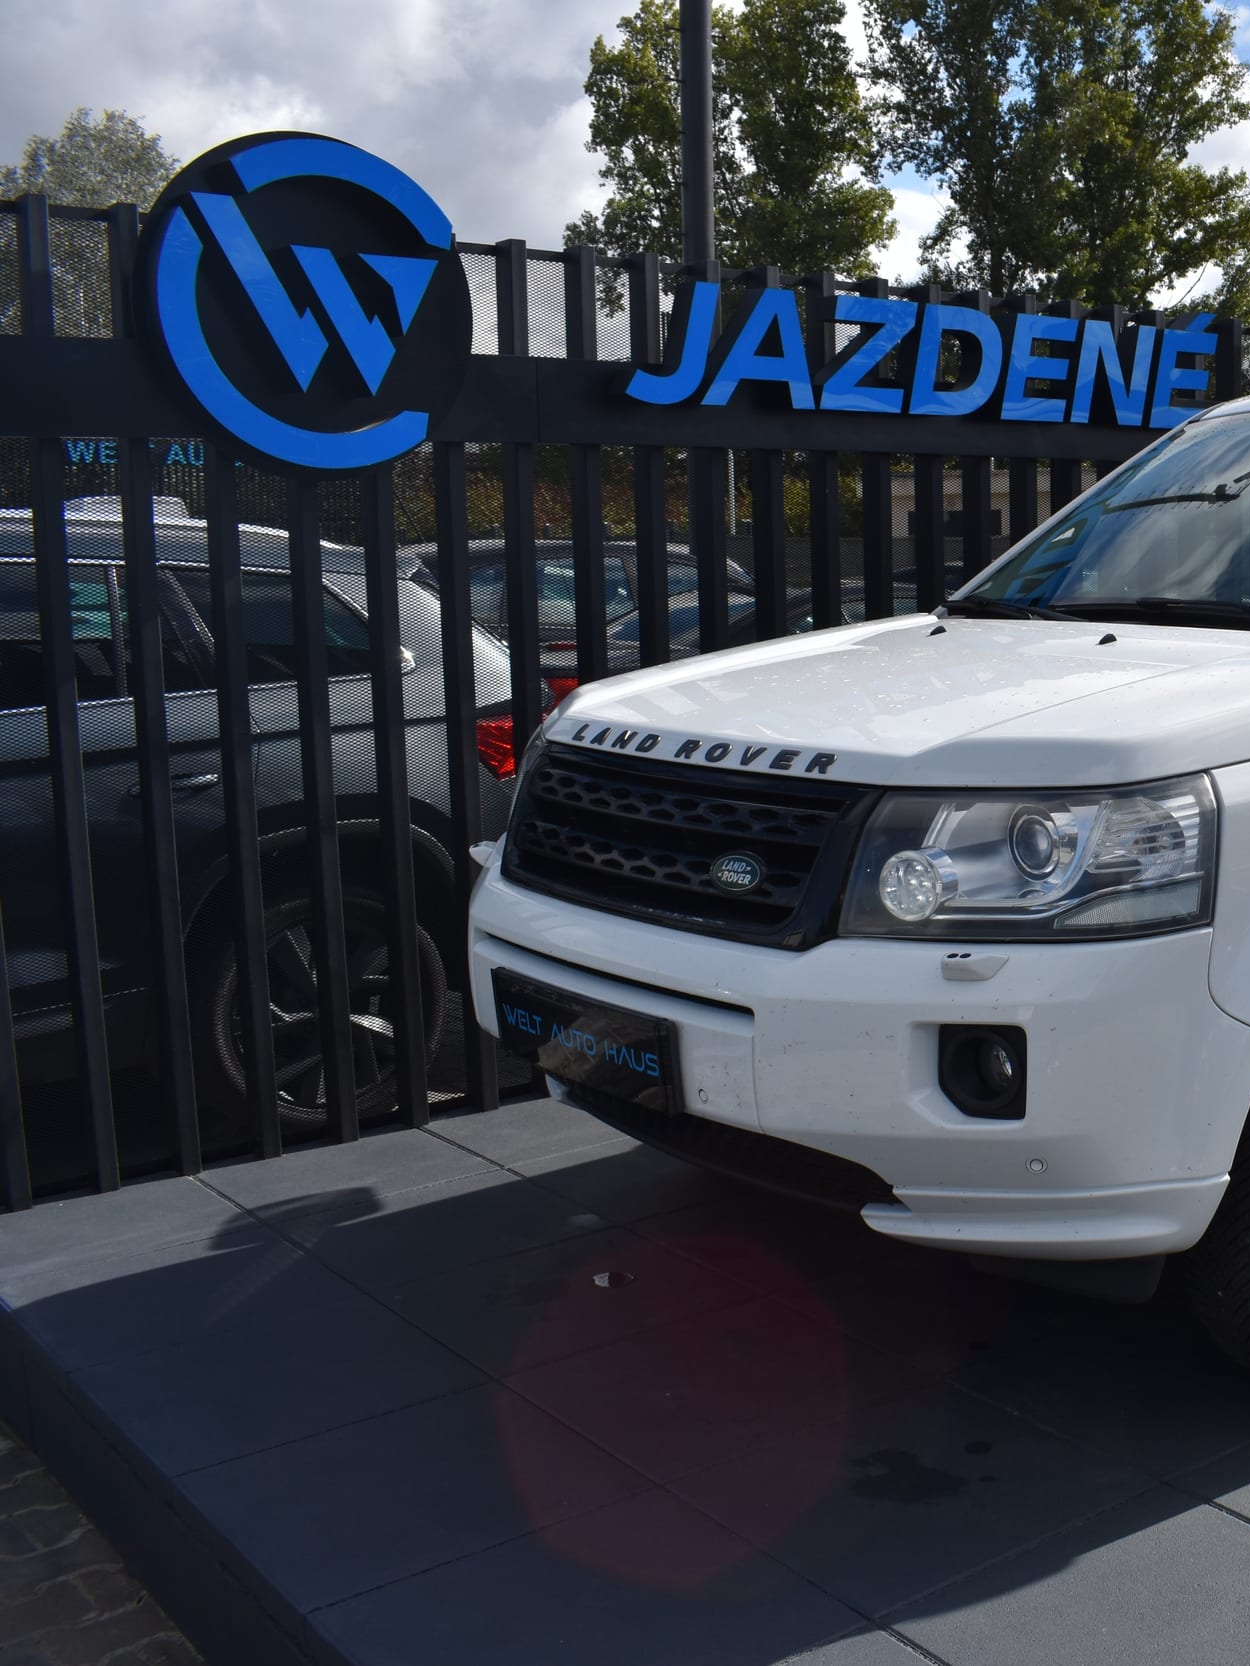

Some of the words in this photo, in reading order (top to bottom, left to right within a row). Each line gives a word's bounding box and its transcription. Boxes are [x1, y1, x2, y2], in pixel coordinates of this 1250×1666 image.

[625, 281, 1218, 429] JAZDENÉ
[571, 723, 662, 753] LAND
[673, 738, 838, 775] ROVER
[721, 870, 752, 885] ROVER
[502, 1003, 543, 1037] WELT
[551, 1023, 597, 1057] AUTO
[604, 1039, 660, 1078] HAUS
